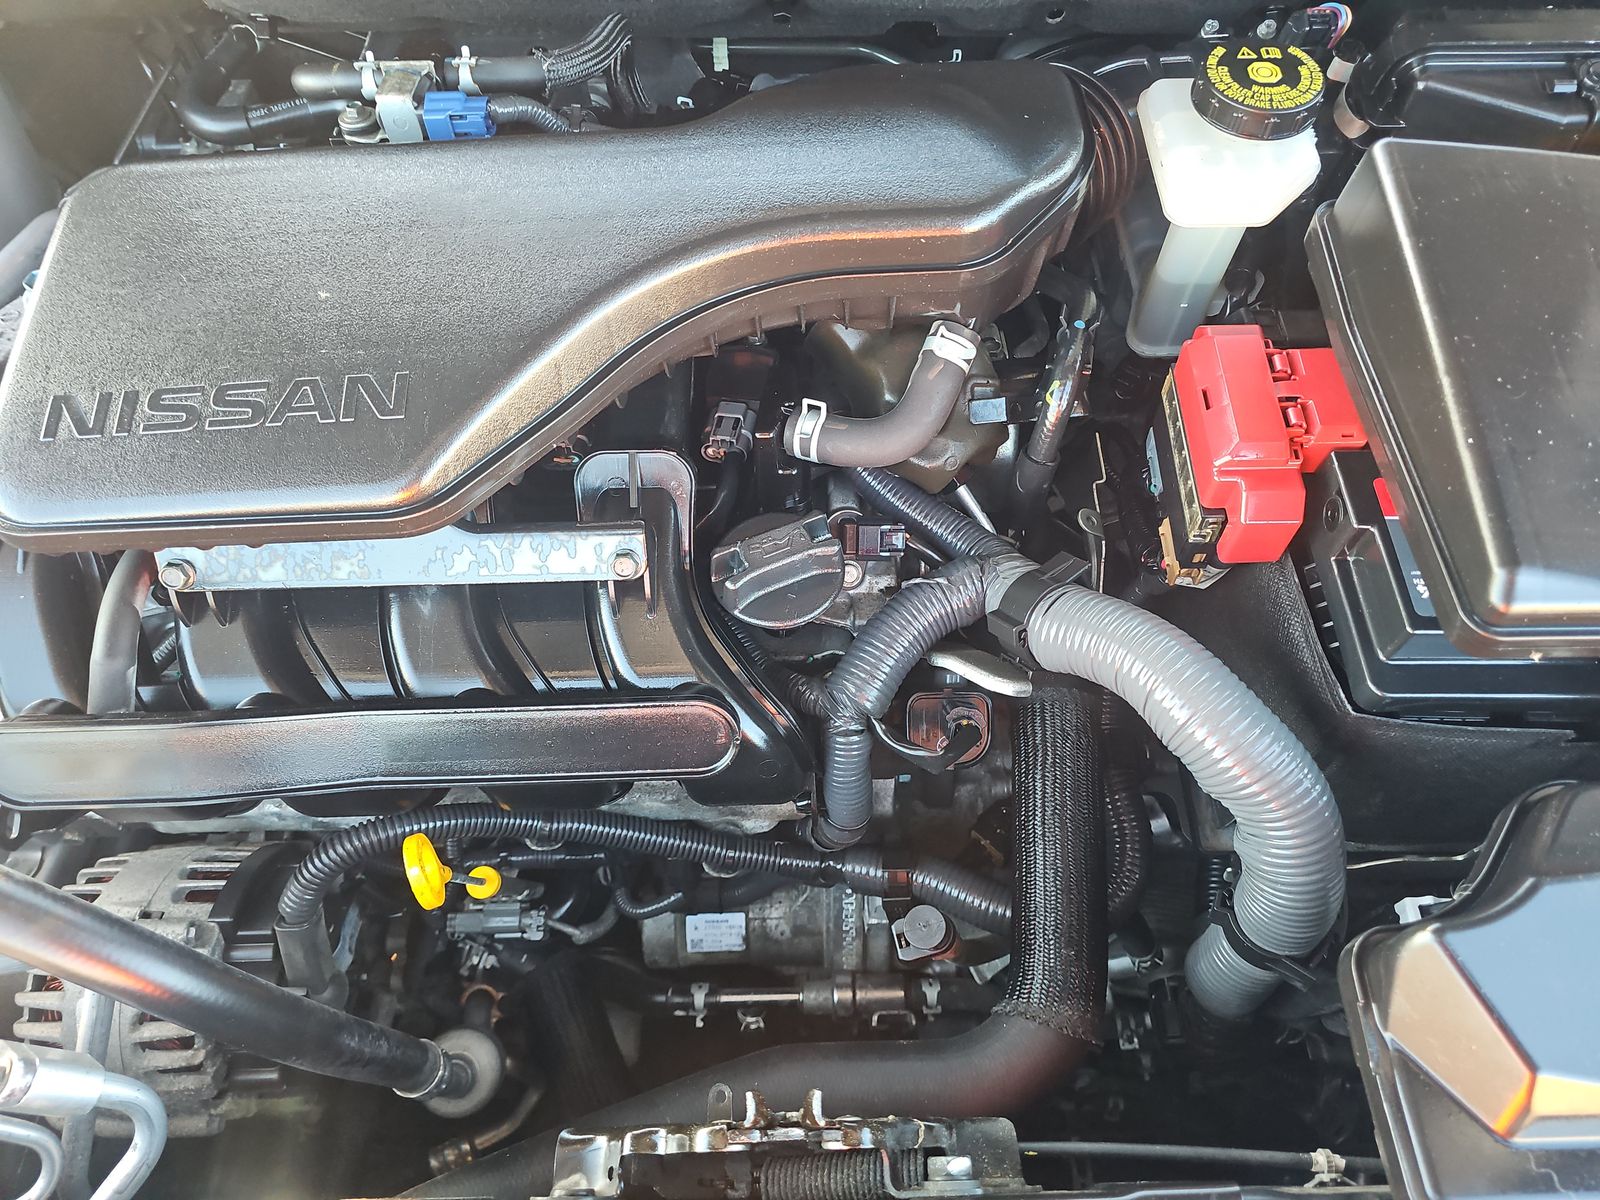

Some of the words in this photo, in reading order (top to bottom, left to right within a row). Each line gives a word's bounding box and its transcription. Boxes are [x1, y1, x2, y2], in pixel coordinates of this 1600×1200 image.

[1252, 84, 1290, 94] WARNING
[1272, 88, 1303, 101] BEFORE
[1243, 97, 1271, 109] BRAKE
[1272, 99, 1296, 109] FLUID
[40, 372, 409, 442] NISSAN
